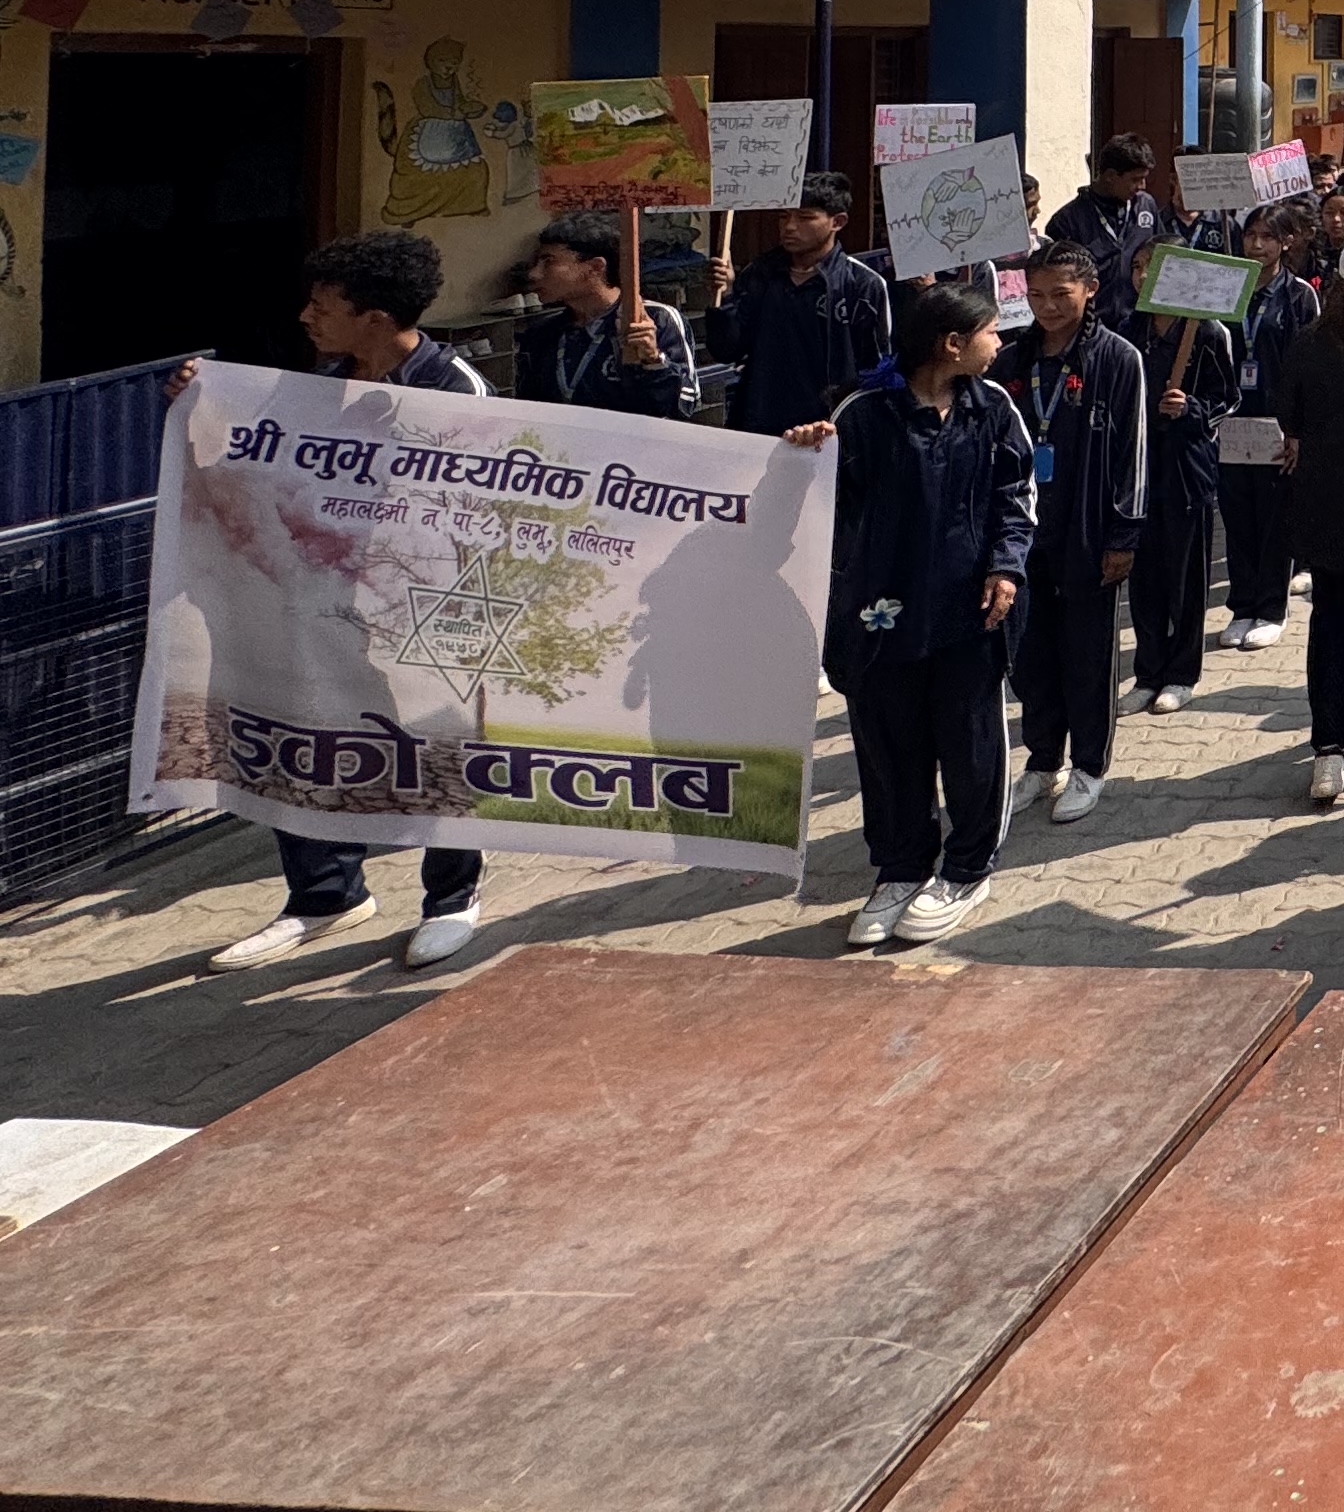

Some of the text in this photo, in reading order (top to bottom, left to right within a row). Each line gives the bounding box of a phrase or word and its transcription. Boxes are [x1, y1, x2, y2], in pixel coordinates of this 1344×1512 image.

[901, 125, 973, 144] the Earth
[226, 419, 749, 525] श्री लुभू माध्यमिक विद्यालय
[320, 496, 407, 524] महालक्ष्मी
[566, 528, 637, 567] ललितपुर
[433, 618, 484, 638] स्थापित
[228, 707, 745, 815] इको क्लब
